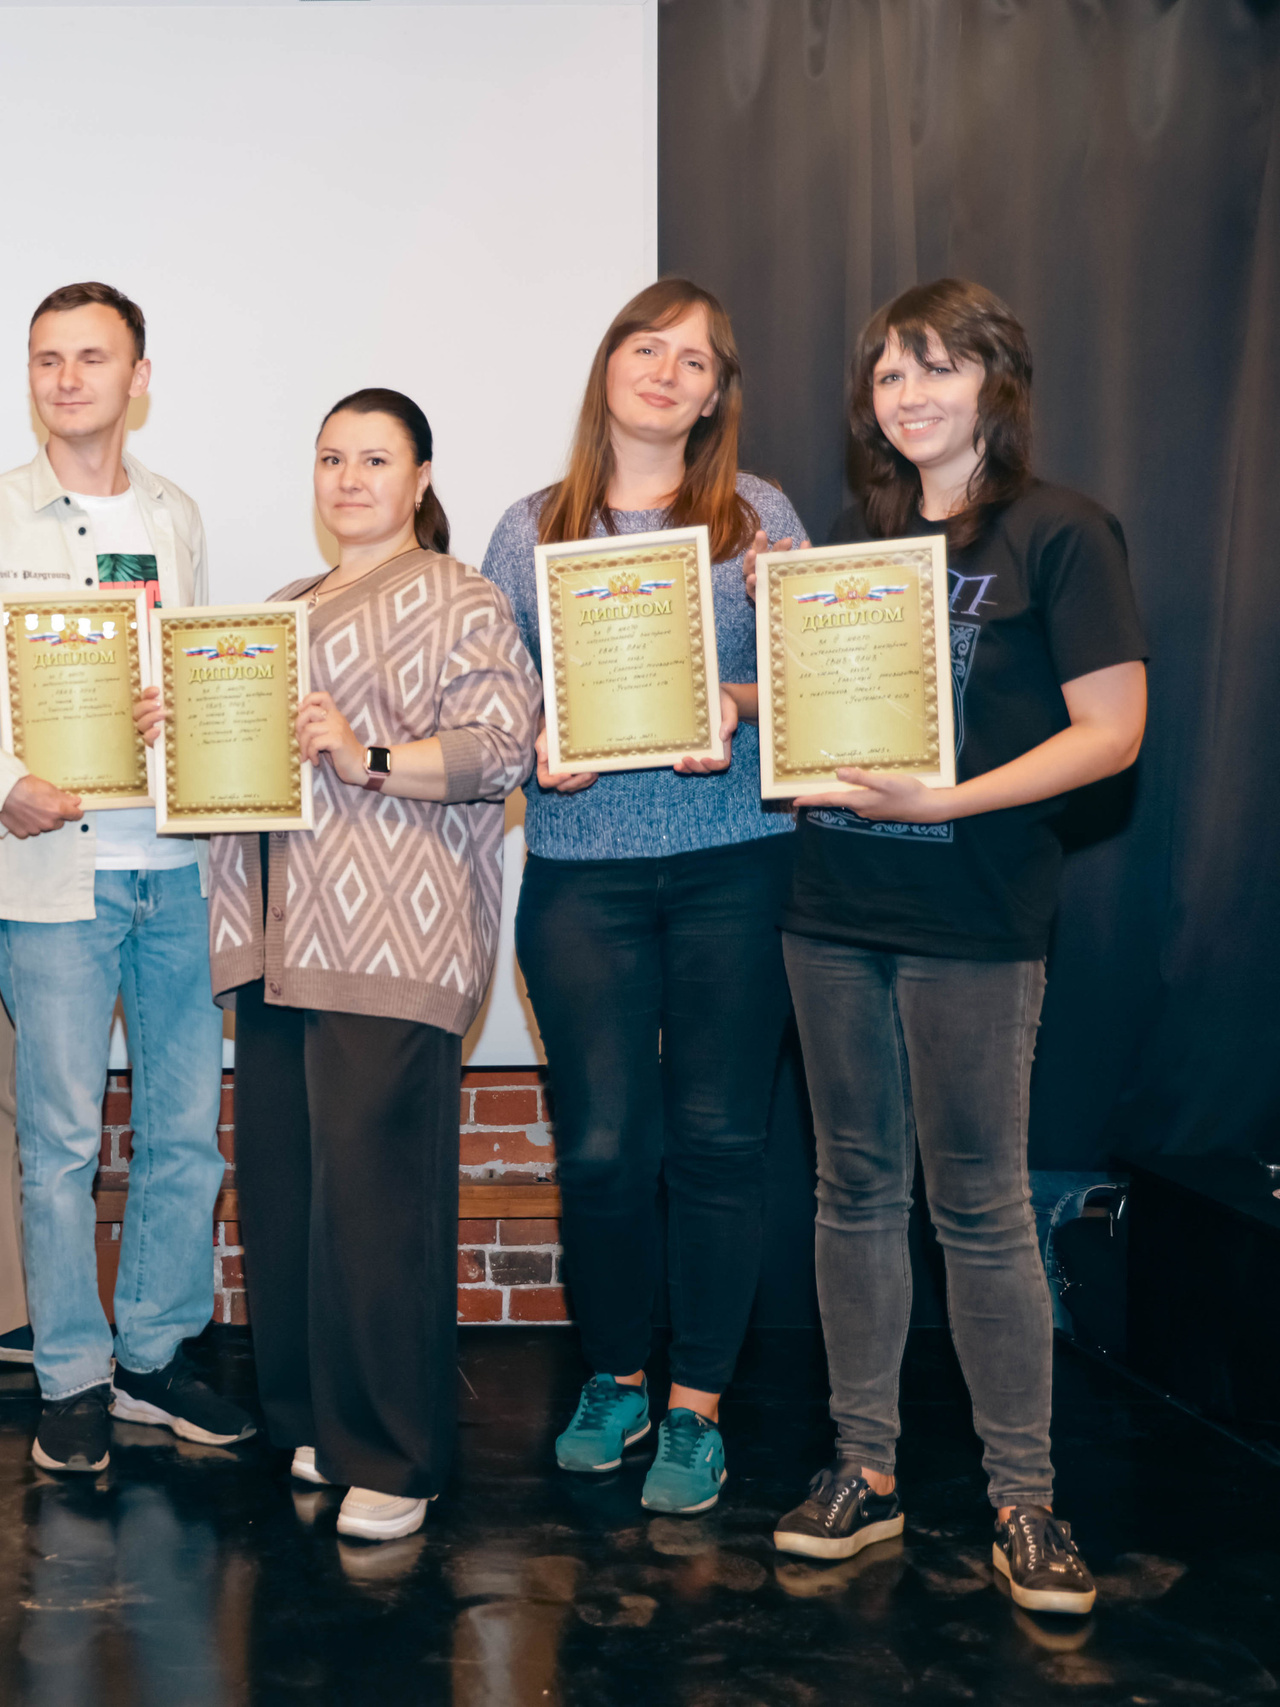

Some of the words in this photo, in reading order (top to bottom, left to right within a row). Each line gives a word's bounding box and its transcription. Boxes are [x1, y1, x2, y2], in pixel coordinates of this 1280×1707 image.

[578, 599, 673, 626] ДИПЛОМ
[801, 606, 905, 633] ДИПЛОМ
[32, 649, 116, 670] ДИПЛОМ
[187, 664, 274, 685] ДИПЛОМ
